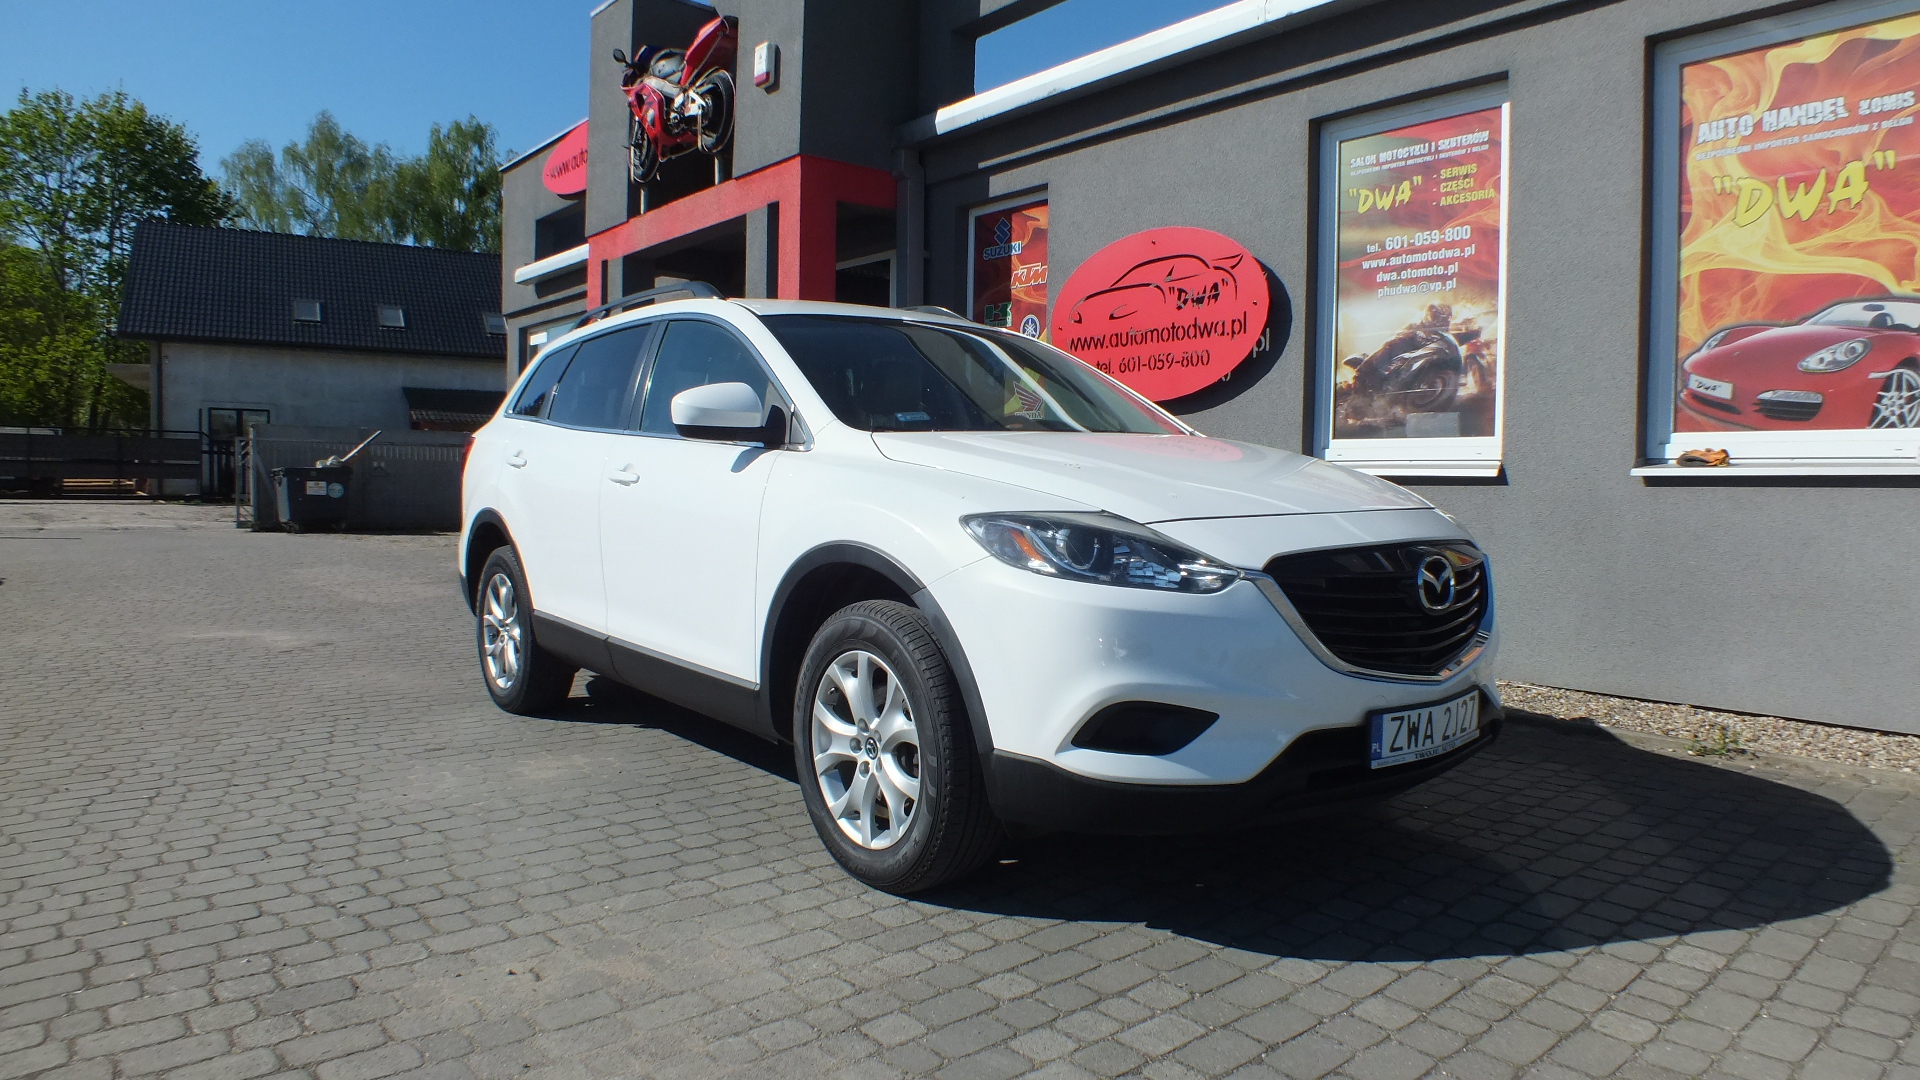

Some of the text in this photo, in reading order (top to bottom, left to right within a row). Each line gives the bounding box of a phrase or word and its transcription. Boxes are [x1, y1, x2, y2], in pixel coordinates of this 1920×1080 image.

[1696, 91, 1915, 145] AUTO HANDEL KOMIS
[1350, 154, 1376, 168] SALON
[1379, 142, 1429, 163] MOTOCYKLI
[1437, 129, 1490, 151] SKUTERÓW
[1754, 135, 1800, 151] IMPORTER
[1872, 121, 1878, 131] Z
[1440, 163, 1477, 180] SERWIS
[1348, 175, 1422, 214] "DWA"
[1440, 177, 1474, 194] CZĘŚCI
[1440, 188, 1495, 206] AKCESORIA
[1712, 150, 1896, 228] "DWA"
[984, 241, 1021, 260] SUZUKI
[1367, 225, 1471, 253] tel. 601-059-800
[1362, 244, 1475, 269] www.automotodwa.pl
[1011, 263, 1048, 288] KTM
[1376, 262, 1458, 282] dwa.otomoto.pl
[1377, 279, 1456, 299] phudwa@vp.pl
[1067, 311, 1247, 352] www.automotodwa.pl
[1119, 349, 1211, 374] 601-059-800
[1389, 695, 1476, 752] ZWA 2J27
[1371, 743, 1381, 753] PL
